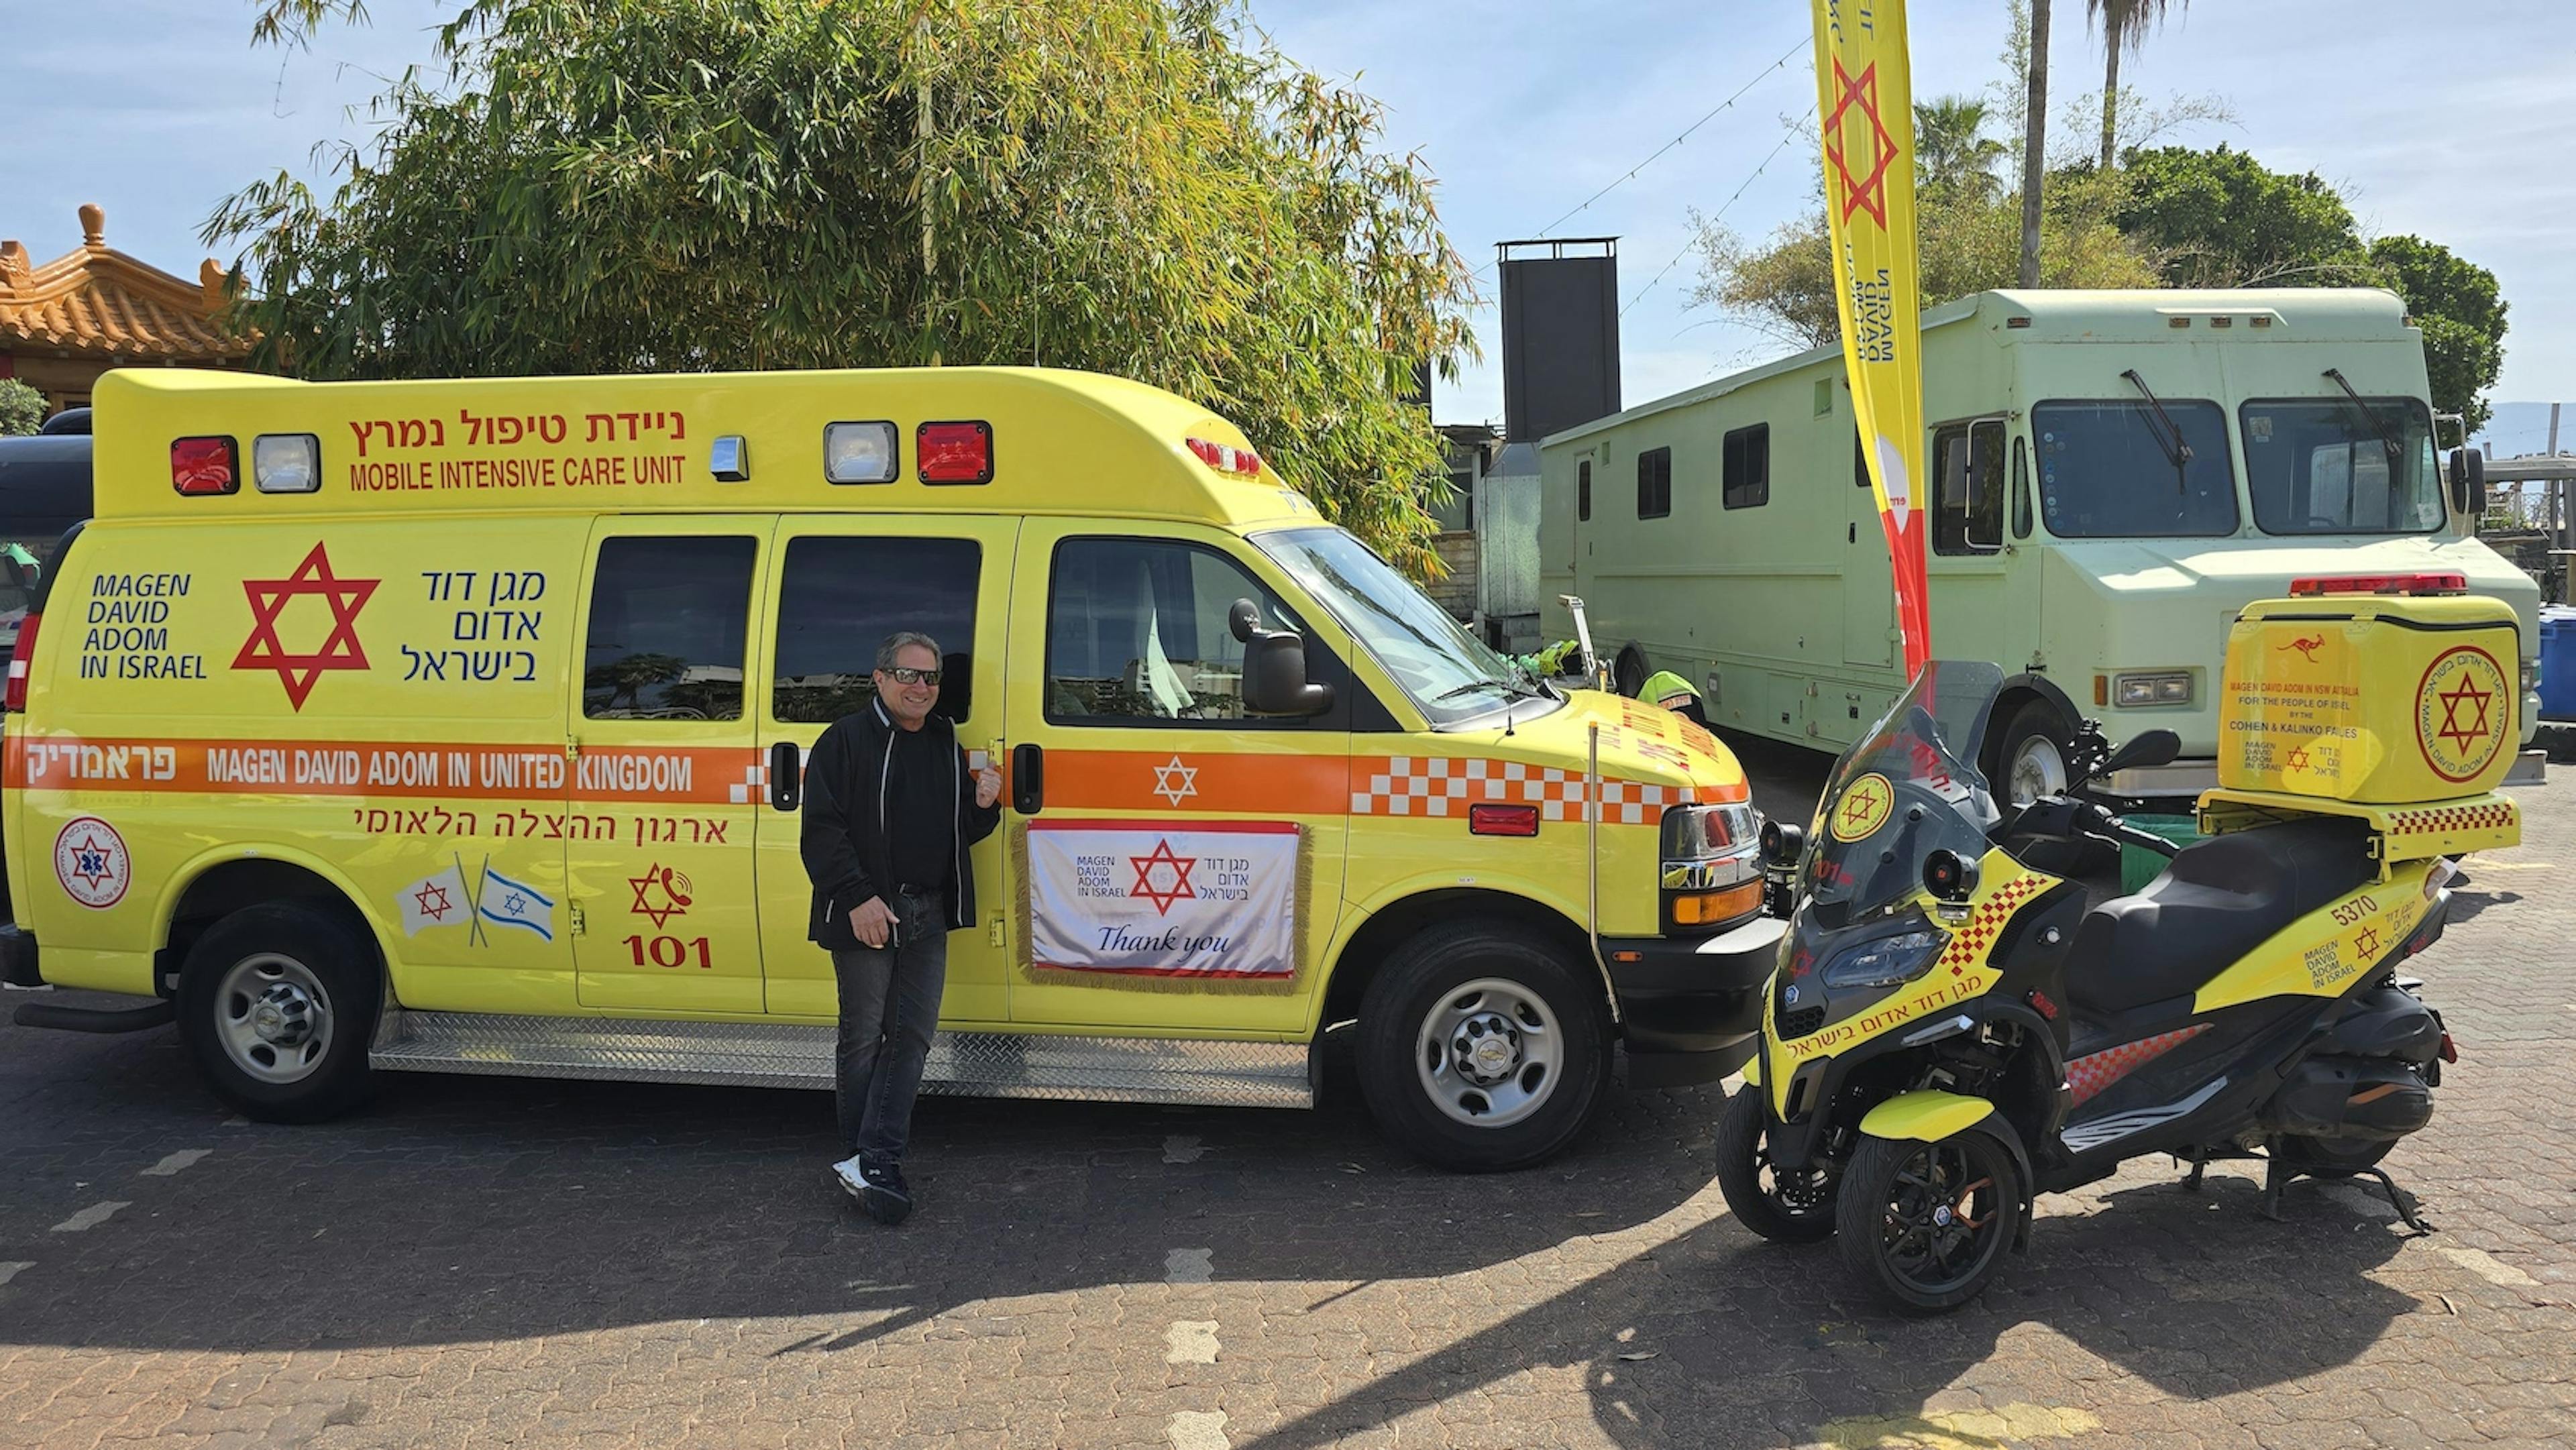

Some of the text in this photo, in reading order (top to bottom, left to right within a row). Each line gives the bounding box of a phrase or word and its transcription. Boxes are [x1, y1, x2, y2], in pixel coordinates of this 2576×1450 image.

[348, 409, 686, 457] ניידת טיפול נמרץ
[350, 455, 686, 491] MOBILE INTENSIVE CARE UNIT
[92, 574, 191, 597] MAGEN
[421, 572, 545, 606] מגן דוד
[88, 601, 169, 623] DAVID
[453, 611, 542, 640] אדום
[83, 627, 167, 651] ADOM
[80, 655, 207, 679] IN ISRAEL
[401, 644, 536, 681] בישראל
[2457, 655, 2481, 666] אדום
[2230, 681, 2258, 692] MAGEN
[2261, 683, 2282, 693] DAVID
[2284, 683, 2304, 693] ADOM
[2306, 685, 2312, 693] IN
[2239, 696, 2259, 706] FOR
[2263, 698, 2279, 706] THE
[2282, 698, 2314, 708] PEOPLE
[2316, 700, 2329, 709] OF
[2289, 711, 2299, 719] BY
[2230, 720, 2269, 732] COHEN
[2271, 723, 2277, 732] &
[2280, 723, 2322, 736] KALINKO
[2422, 704, 2505, 773] MAGEN DAVID ADOM IN ISRAEL
[2245, 742, 2276, 750] MAGEN
[2245, 748, 2271, 757] DAVID
[27, 744, 176, 784] פראמדיק
[207, 748, 692, 792] MAGEN DAVID ADOM IN UNITED KINGDOM
[354, 805, 729, 848] ארגון ההצלה הלאומי
[1077, 856, 1115, 866] MAGEN
[1077, 867, 1110, 877] DAVID
[1204, 858, 1250, 873] מגן דוד
[1078, 877, 1110, 887] ADOM
[1218, 874, 1249, 886] אדום
[1078, 887, 1126, 898] IN ISRAEL
[1199, 885, 1249, 901] בישראל
[2330, 895, 2377, 926] 5370
[622, 935, 712, 968] 101
[1098, 924, 1231, 963] Thank you
[2304, 940, 2339, 961] MAGEN
[2307, 951, 2336, 970] DAVID
[2312, 960, 2339, 979] ADOM
[2326, 963, 2356, 985] ISRAEL
[1786, 975, 1982, 1059] מגן דוד אדום בישראל
